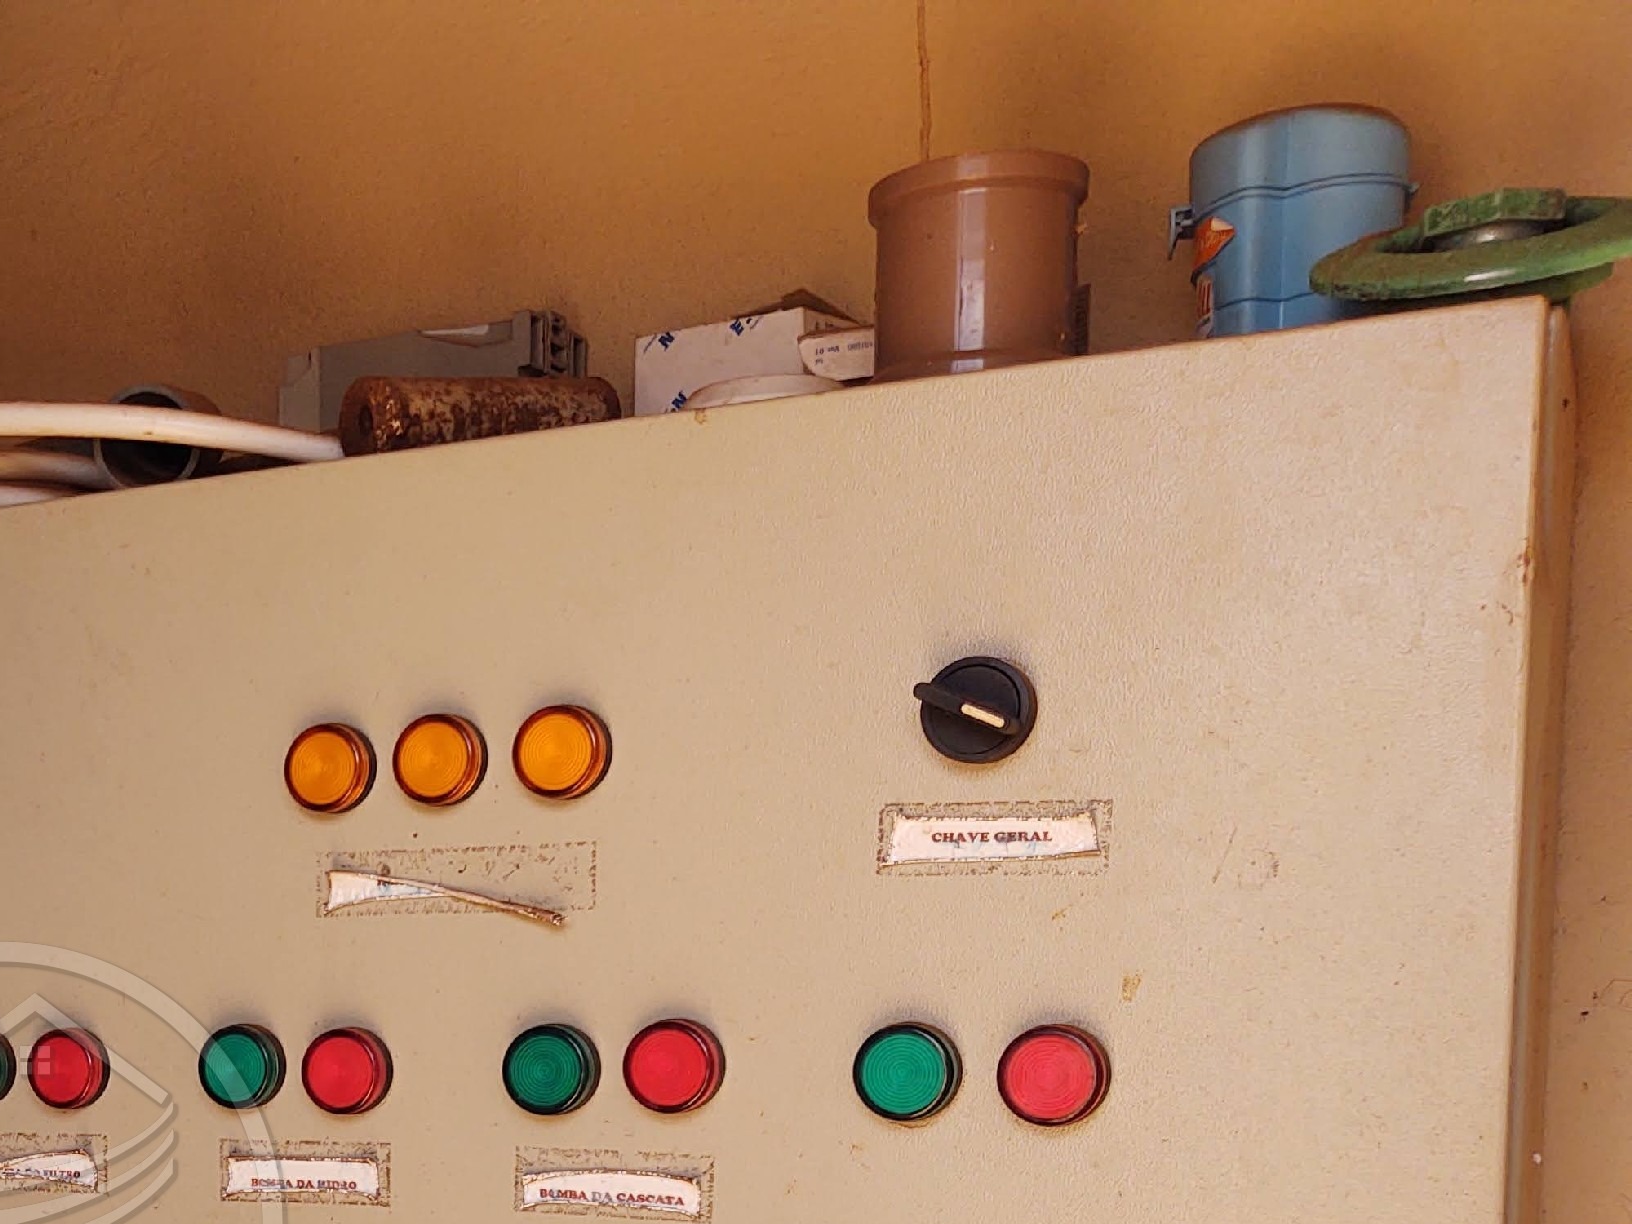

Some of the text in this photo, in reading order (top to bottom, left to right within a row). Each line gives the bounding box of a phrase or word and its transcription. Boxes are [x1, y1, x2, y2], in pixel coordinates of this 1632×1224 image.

[931, 830, 1053, 843] CHAVE GERAL
[297, 1179, 315, 1190] DA
[539, 1188, 685, 1206] BOMBA DA CASCATA
